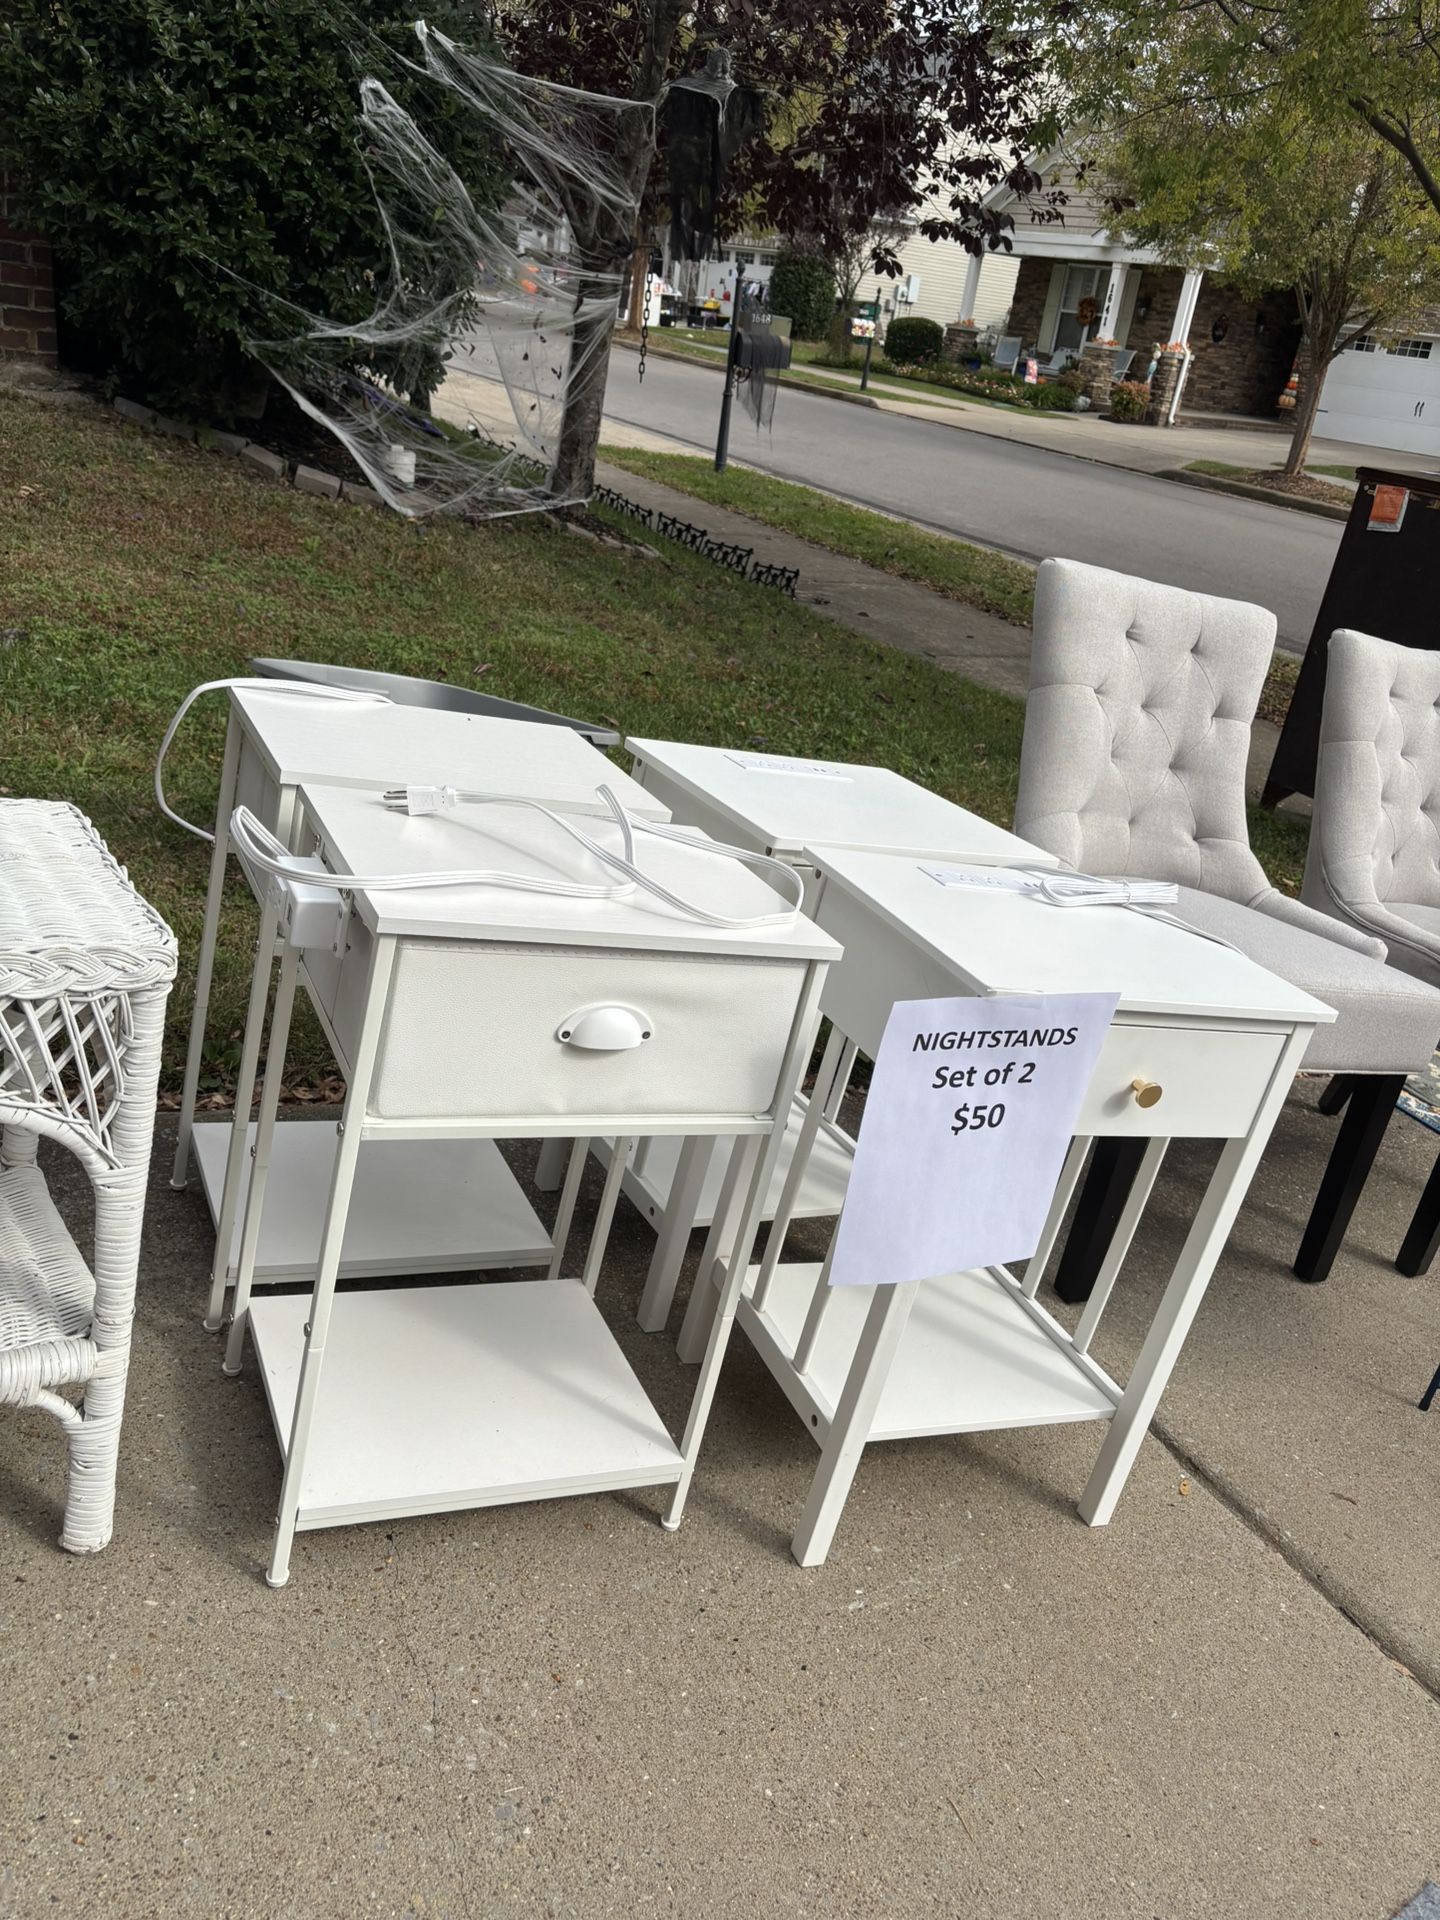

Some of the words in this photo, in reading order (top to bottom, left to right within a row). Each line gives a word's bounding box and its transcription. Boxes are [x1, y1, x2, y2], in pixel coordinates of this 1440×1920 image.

[751, 313, 771, 324] 1648
[1103, 283, 1114, 327] 1641
[912, 1027, 1079, 1052] NIGHTSTANDS
[932, 1066, 977, 1089] Set
[984, 1062, 1016, 1085] of
[1018, 1062, 1036, 1084] 2
[951, 1103, 1005, 1136] $50
